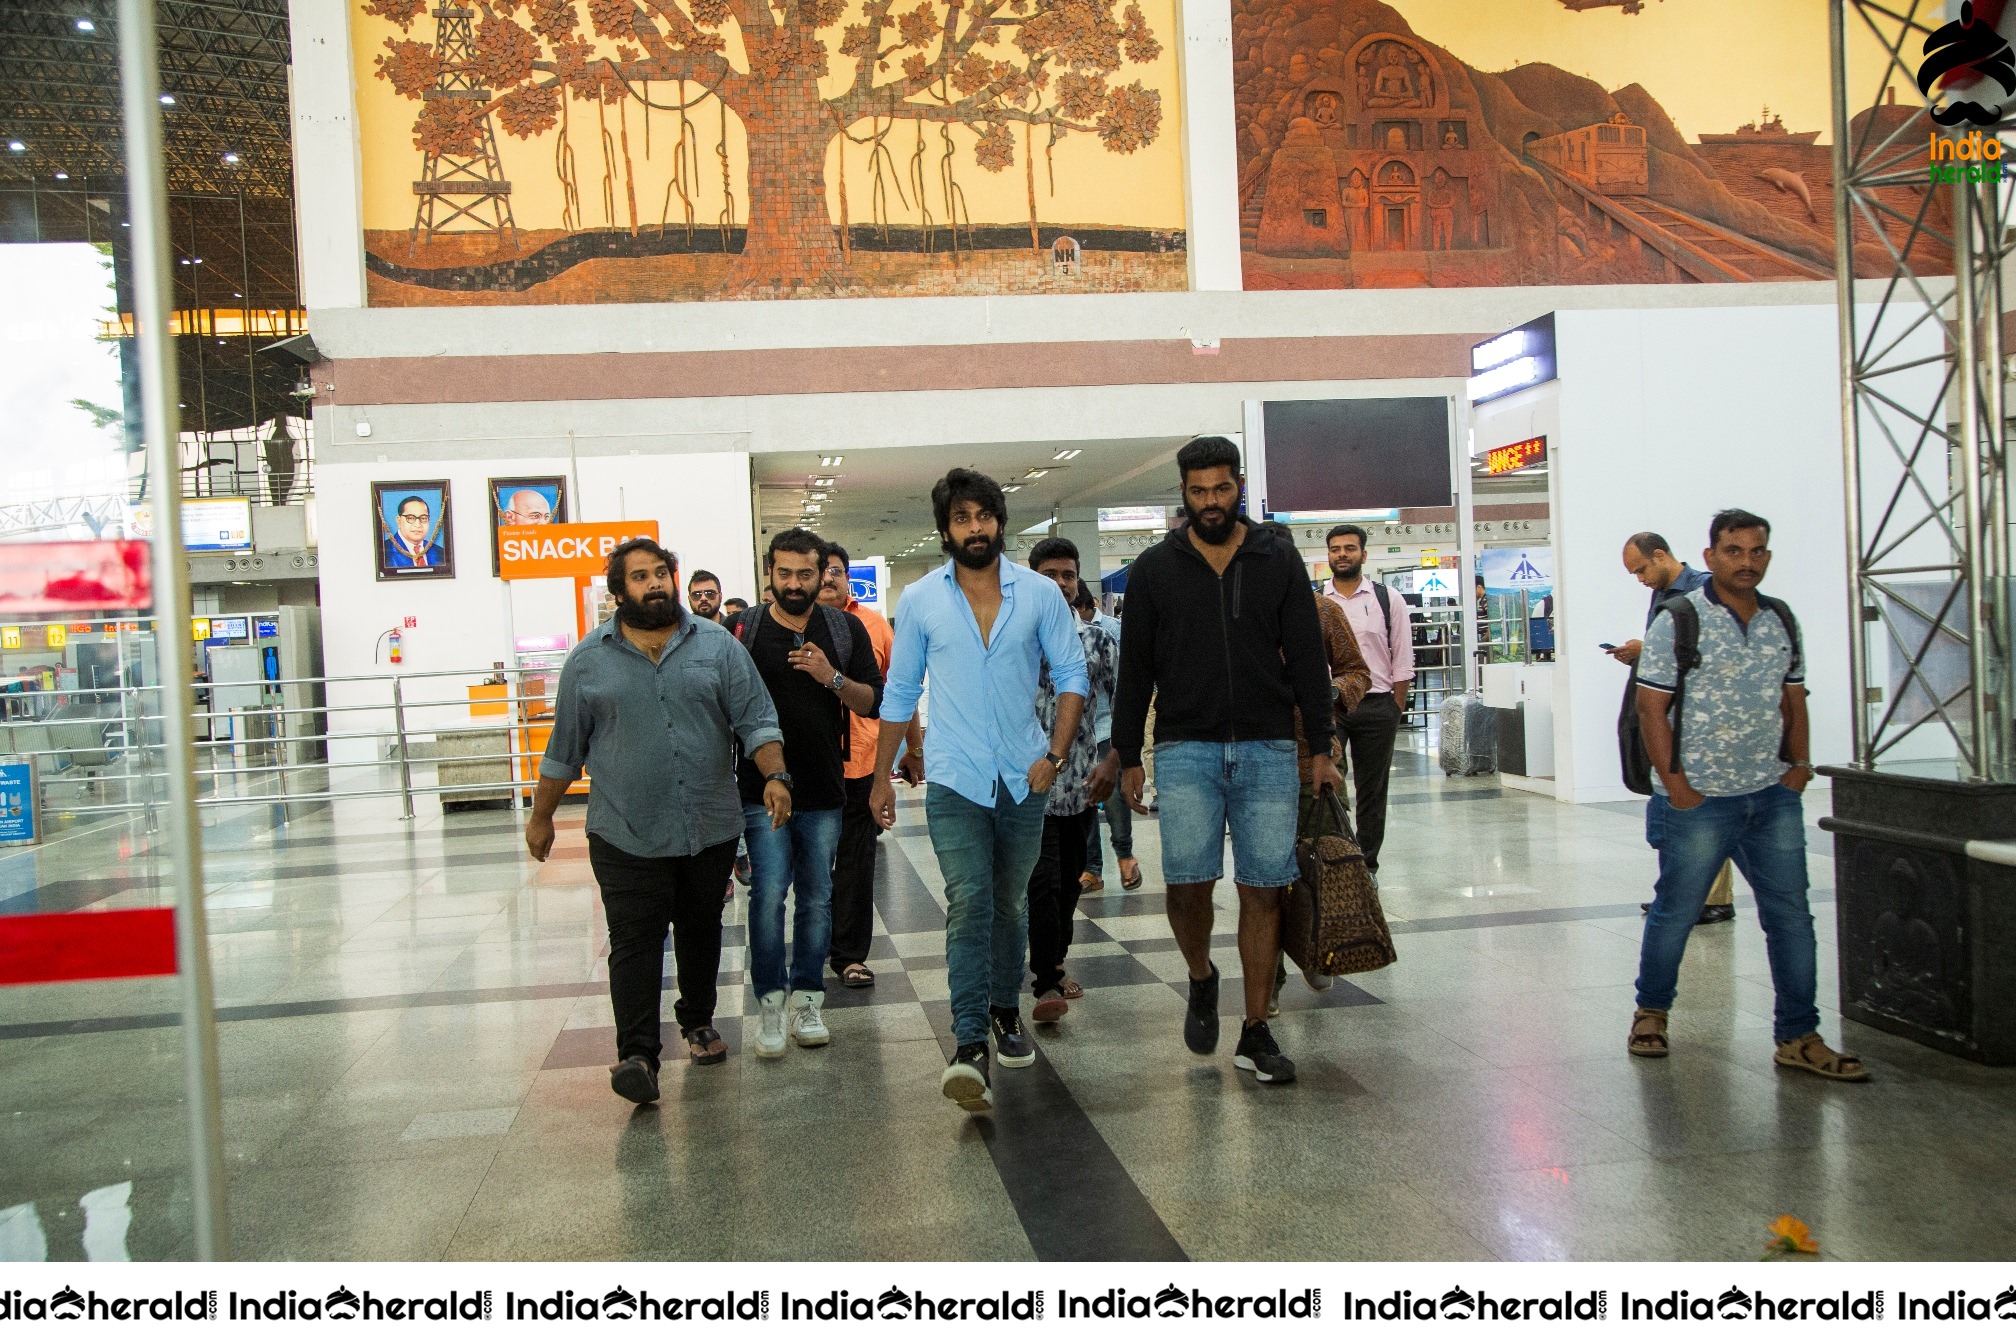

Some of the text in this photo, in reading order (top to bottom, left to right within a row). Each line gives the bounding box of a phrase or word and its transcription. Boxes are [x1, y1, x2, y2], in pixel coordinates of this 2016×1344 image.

[1055, 248, 1074, 262] NH
[503, 537, 594, 561] SNACK
[196, 629, 207, 639] 14
[7, 636, 18, 647] 11
